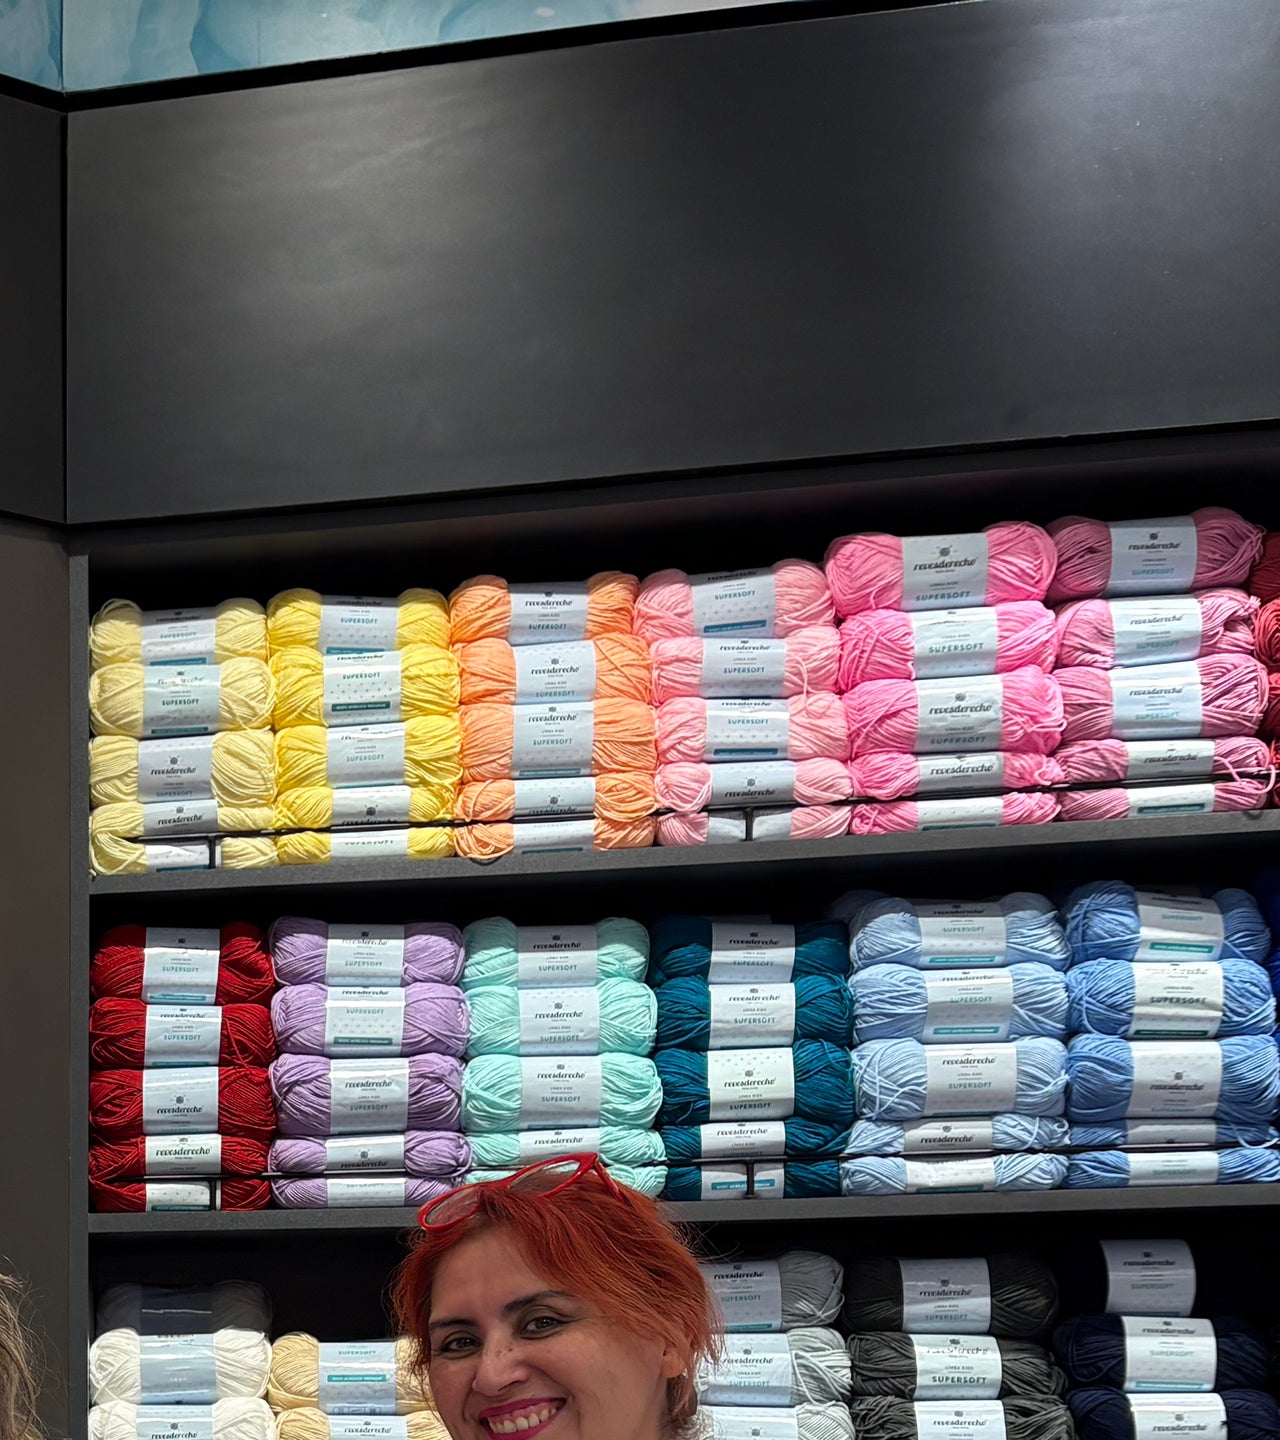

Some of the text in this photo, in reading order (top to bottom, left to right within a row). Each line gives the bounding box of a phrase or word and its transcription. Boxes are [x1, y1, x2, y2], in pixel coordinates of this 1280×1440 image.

[714, 590, 756, 600] SUPERSOFT
[929, 643, 984, 654] SUPERSOFT
[724, 666, 764, 674] SUPERSOFT
[931, 736, 986, 744] SUPERSOFT
[932, 1376, 987, 1384] SUPERSOFT
